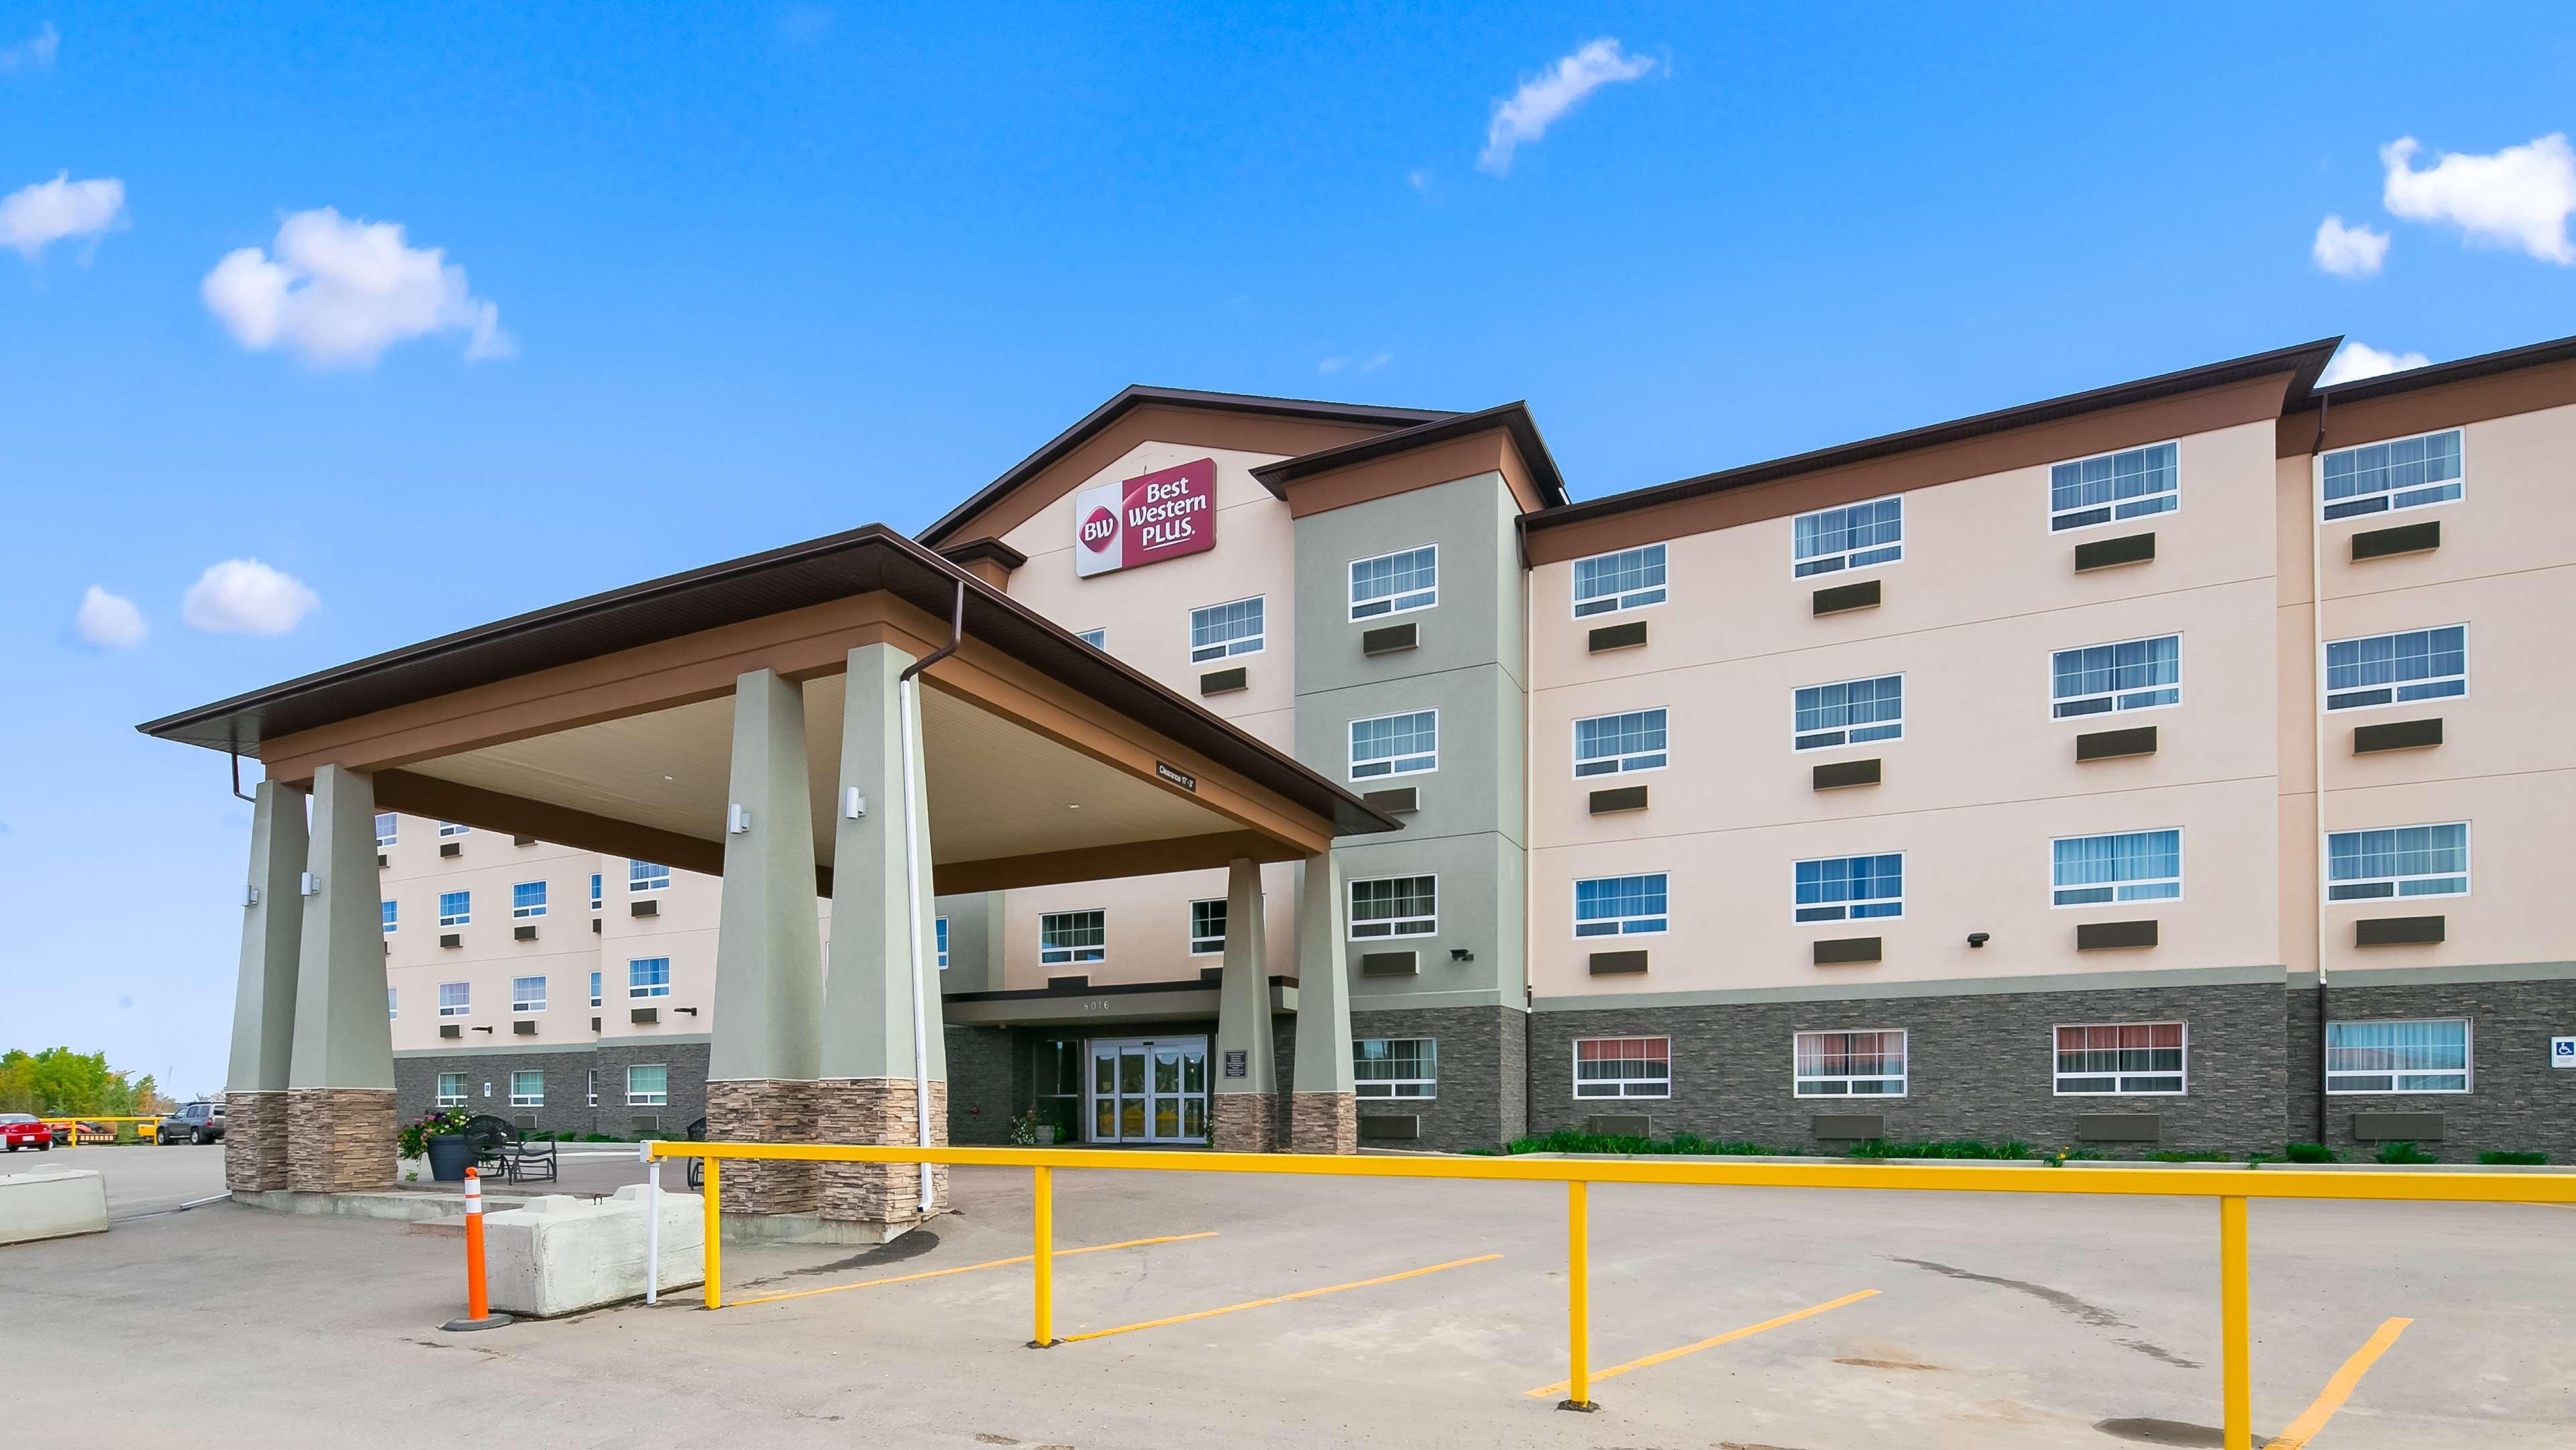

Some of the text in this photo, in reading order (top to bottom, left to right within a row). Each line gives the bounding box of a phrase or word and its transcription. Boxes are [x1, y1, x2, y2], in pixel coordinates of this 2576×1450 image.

[1147, 477, 1189, 503] Best
[1128, 495, 1207, 527] Western
[1084, 518, 1114, 541] BW
